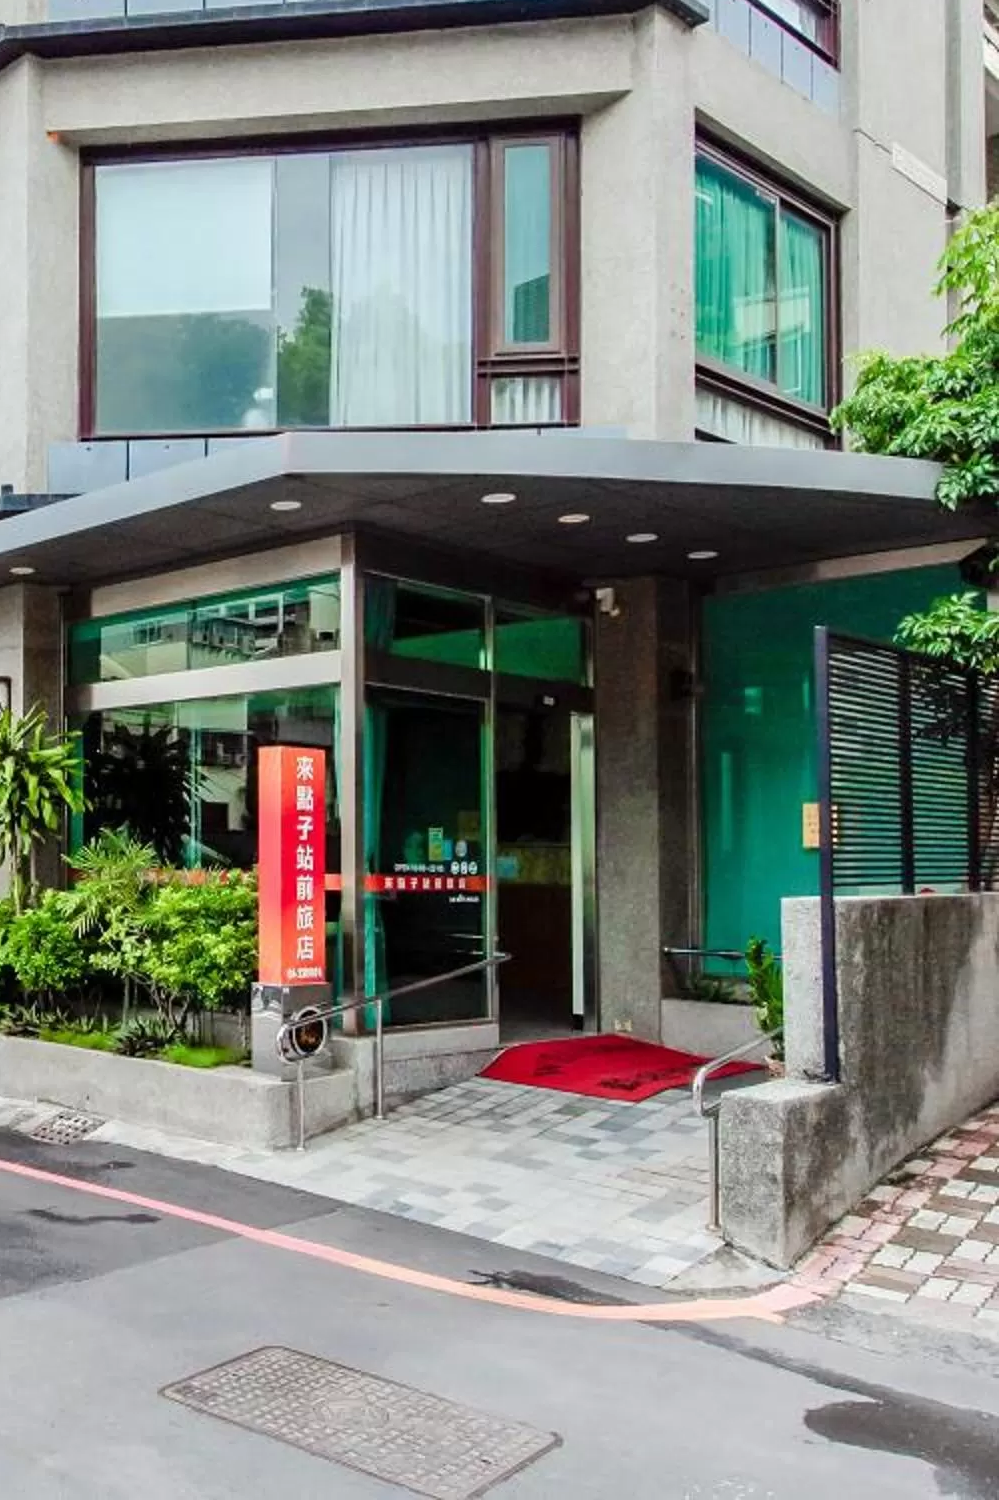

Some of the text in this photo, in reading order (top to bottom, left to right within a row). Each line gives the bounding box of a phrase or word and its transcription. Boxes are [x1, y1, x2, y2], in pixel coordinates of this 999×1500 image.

[295, 756, 314, 961] 來點子站前旅店
